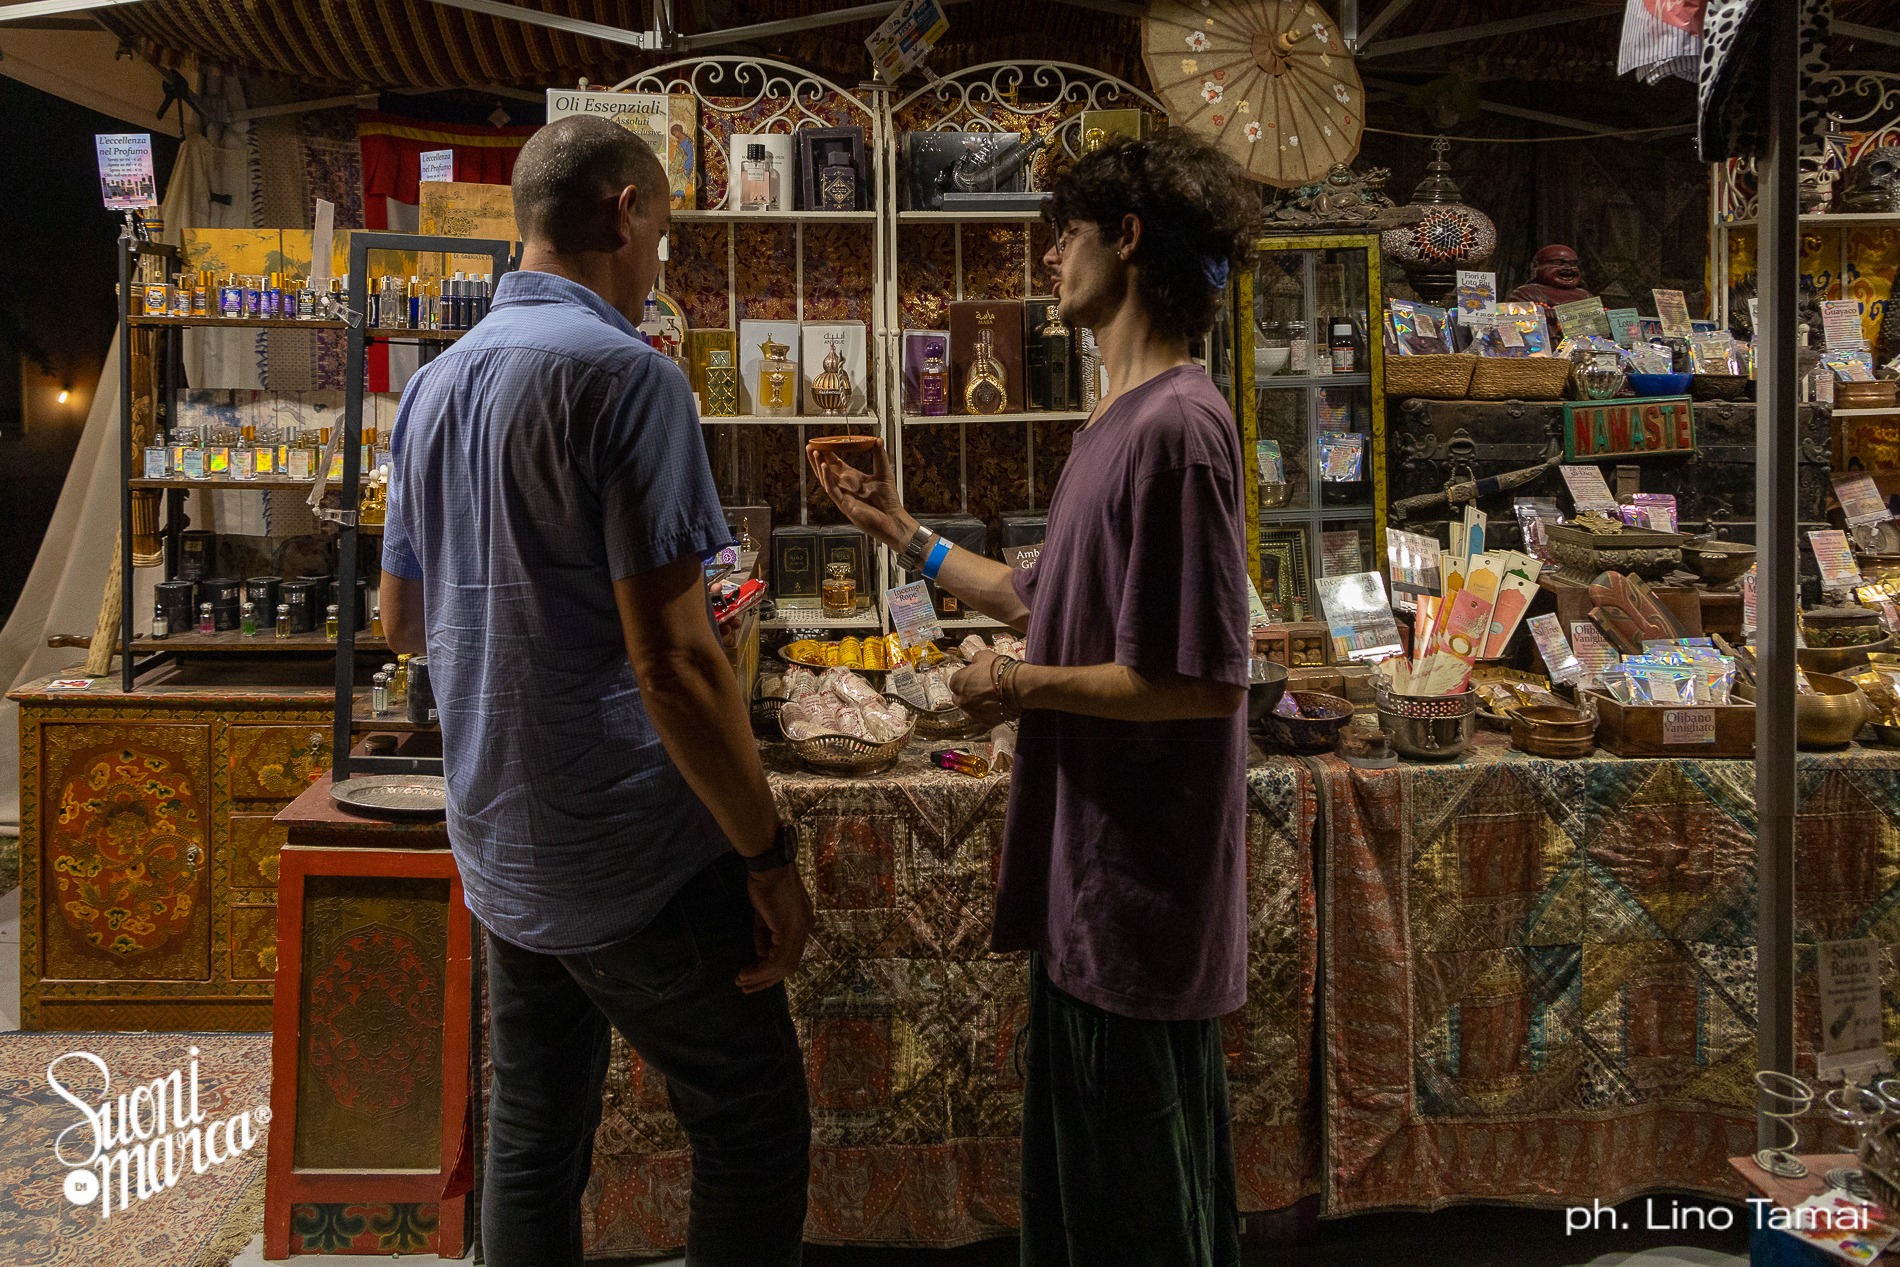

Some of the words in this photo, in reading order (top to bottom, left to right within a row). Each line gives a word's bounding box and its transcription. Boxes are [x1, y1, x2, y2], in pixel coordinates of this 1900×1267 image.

[556, 97, 579, 112] Oli
[584, 98, 661, 114] Essenziali
[616, 116, 650, 126] Assoluti
[99, 136, 147, 145] L'eccellenza
[99, 148, 112, 156] nel
[113, 147, 149, 157] Profumo
[422, 153, 451, 163] L'eccellenza
[422, 164, 430, 173] nel
[430, 163, 452, 173] Profumo
[1464, 272, 1479, 280] Fiori
[1461, 279, 1477, 287] Loto
[1578, 310, 1600, 318] Bianco
[1824, 308, 1857, 317] Guayaco
[1617, 319, 1634, 328] Loto
[1574, 405, 1690, 455] NAMASTE
[1016, 549, 1040, 560] Amb
[893, 584, 920, 596] Incenso
[900, 592, 918, 602] Rope
[1667, 712, 1711, 723] Olibano
[1664, 721, 1714, 734] Vanigliato
